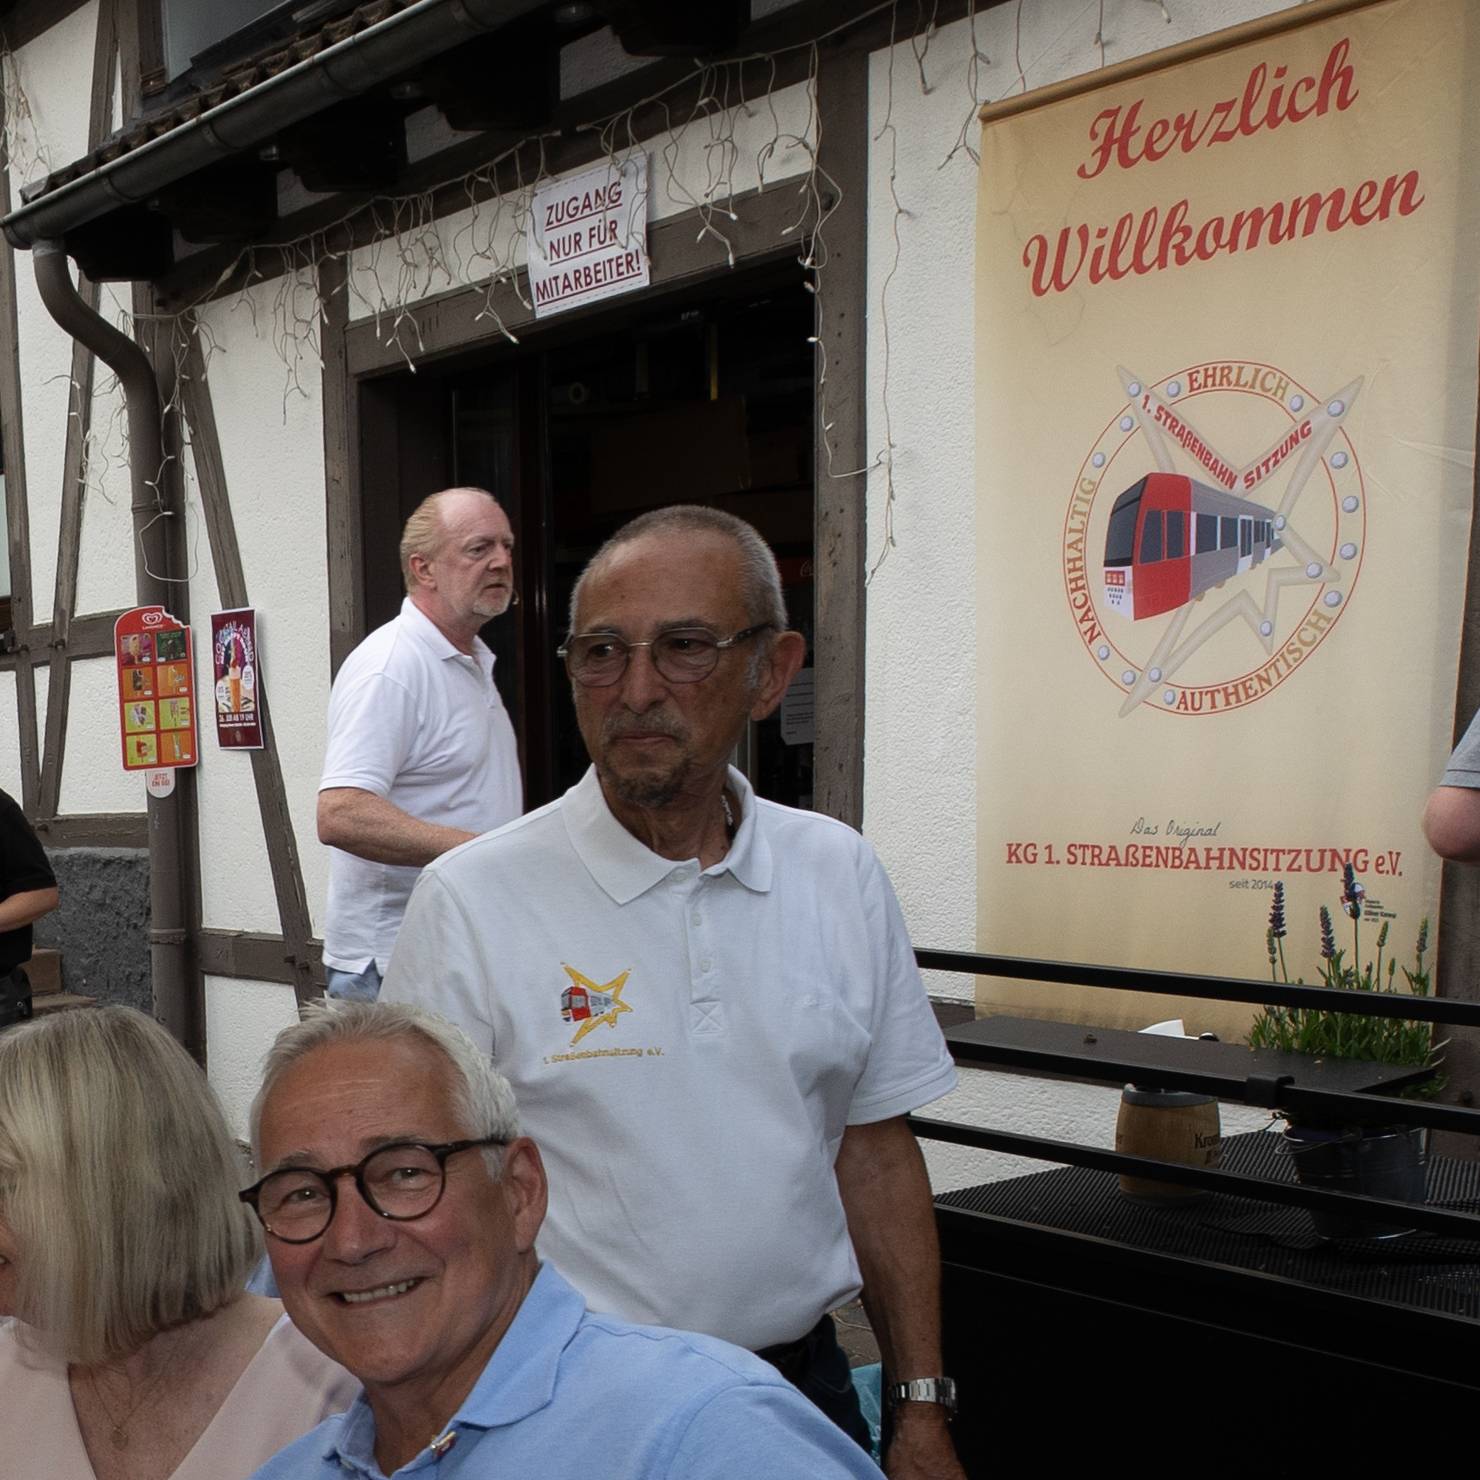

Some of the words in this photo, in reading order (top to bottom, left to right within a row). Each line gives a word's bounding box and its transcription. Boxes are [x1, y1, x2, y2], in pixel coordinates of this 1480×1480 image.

[1076, 37, 1360, 180] Herzlich
[545, 181, 623, 228] ZUGANG
[549, 231, 583, 262] NUR
[588, 218, 619, 250] FÜR
[1023, 170, 1426, 297] Willkommen
[535, 248, 642, 303] MITARBEITER!
[1186, 365, 1293, 402] EHRLICH
[1242, 420, 1313, 491] SITZUNG
[1064, 475, 1103, 646] NACHHALTIG
[1175, 607, 1336, 714] AUTHENTISCH
[1005, 842, 1039, 866] KG
[1043, 844, 1062, 866] 1.
[1130, 817, 1159, 836] Das
[1166, 820, 1222, 849] Original
